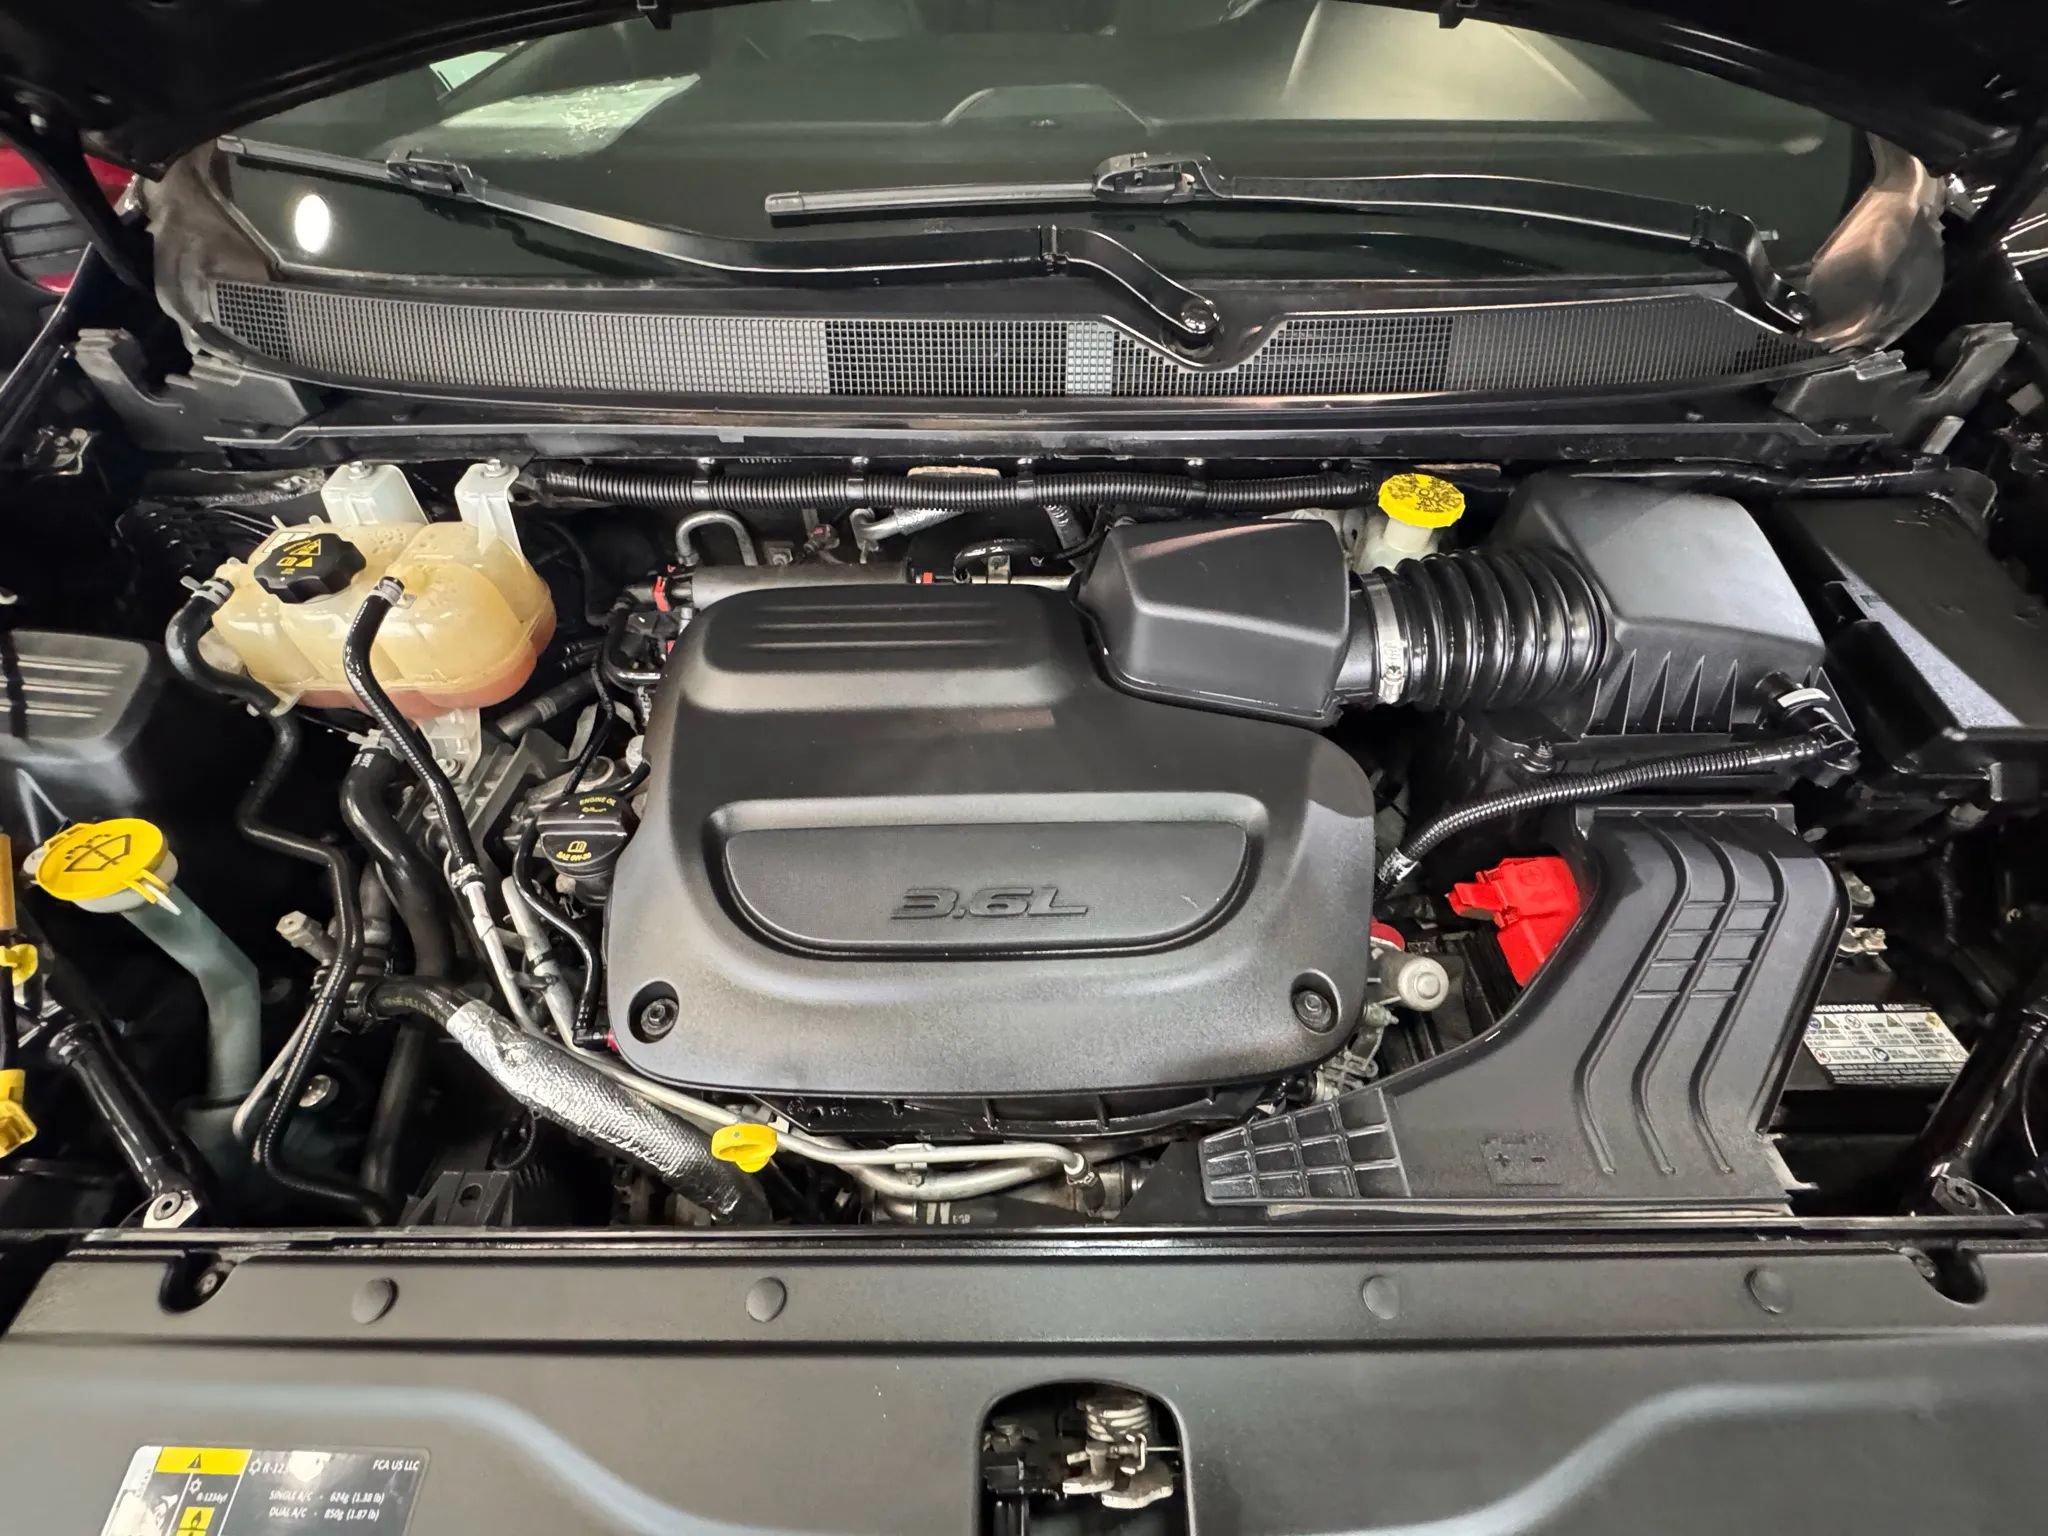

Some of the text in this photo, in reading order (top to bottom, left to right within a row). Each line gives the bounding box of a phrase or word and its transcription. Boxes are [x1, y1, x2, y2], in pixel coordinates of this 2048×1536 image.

[579, 797, 617, 807] ENGINE OIL
[890, 886, 1089, 920] 3.6L
[372, 1459, 421, 1472] FCA US LLC
[268, 1489, 297, 1502] SINGLE
[297, 1490, 314, 1503] A/C
[268, 1506, 290, 1518] DUAL
[291, 1506, 308, 1519] A/C
